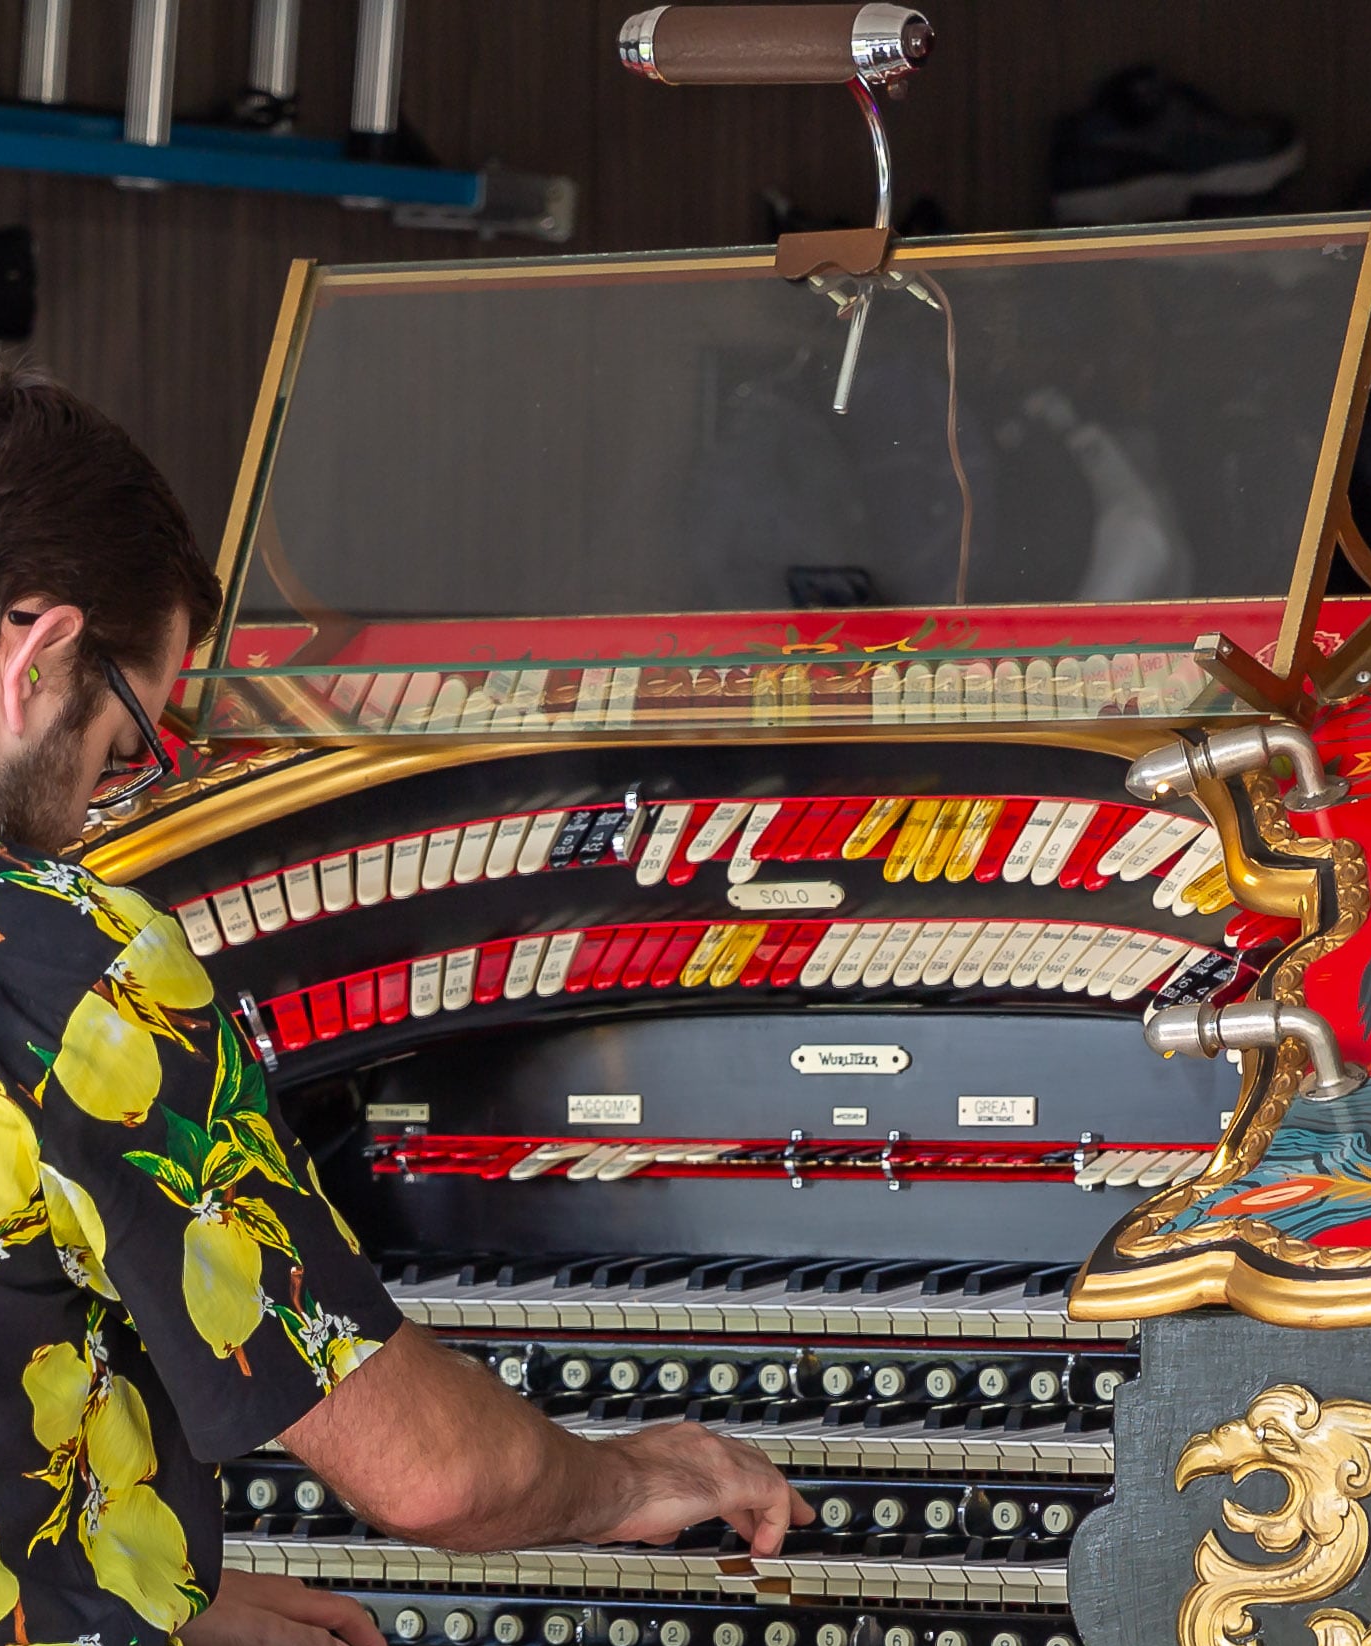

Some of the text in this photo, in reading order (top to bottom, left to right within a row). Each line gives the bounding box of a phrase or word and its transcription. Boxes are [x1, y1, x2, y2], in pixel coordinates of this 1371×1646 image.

[760, 889, 810, 904] SOLO
[974, 1100, 1017, 1114] GREAT
[882, 1374, 892, 1389] 2
[934, 1376, 944, 1391] 3
[986, 1374, 998, 1389] 4
[1038, 1378, 1048, 1393] 5
[1102, 1377, 1112, 1393] 6
[256, 1486, 265, 1501] 9
[829, 1506, 839, 1520] 3
[880, 1506, 892, 1521] 4
[934, 1507, 944, 1522] 5
[1000, 1507, 1011, 1523] 6
[1051, 1512, 1061, 1526] 7
[500, 1622, 514, 1636] FF
[546, 1623, 565, 1636] FFF
[617, 1627, 626, 1642] 1
[668, 1627, 679, 1643] 2
[721, 1630, 732, 1645] 3
[771, 1628, 784, 1645] 4
[825, 1631, 834, 1646] 5
